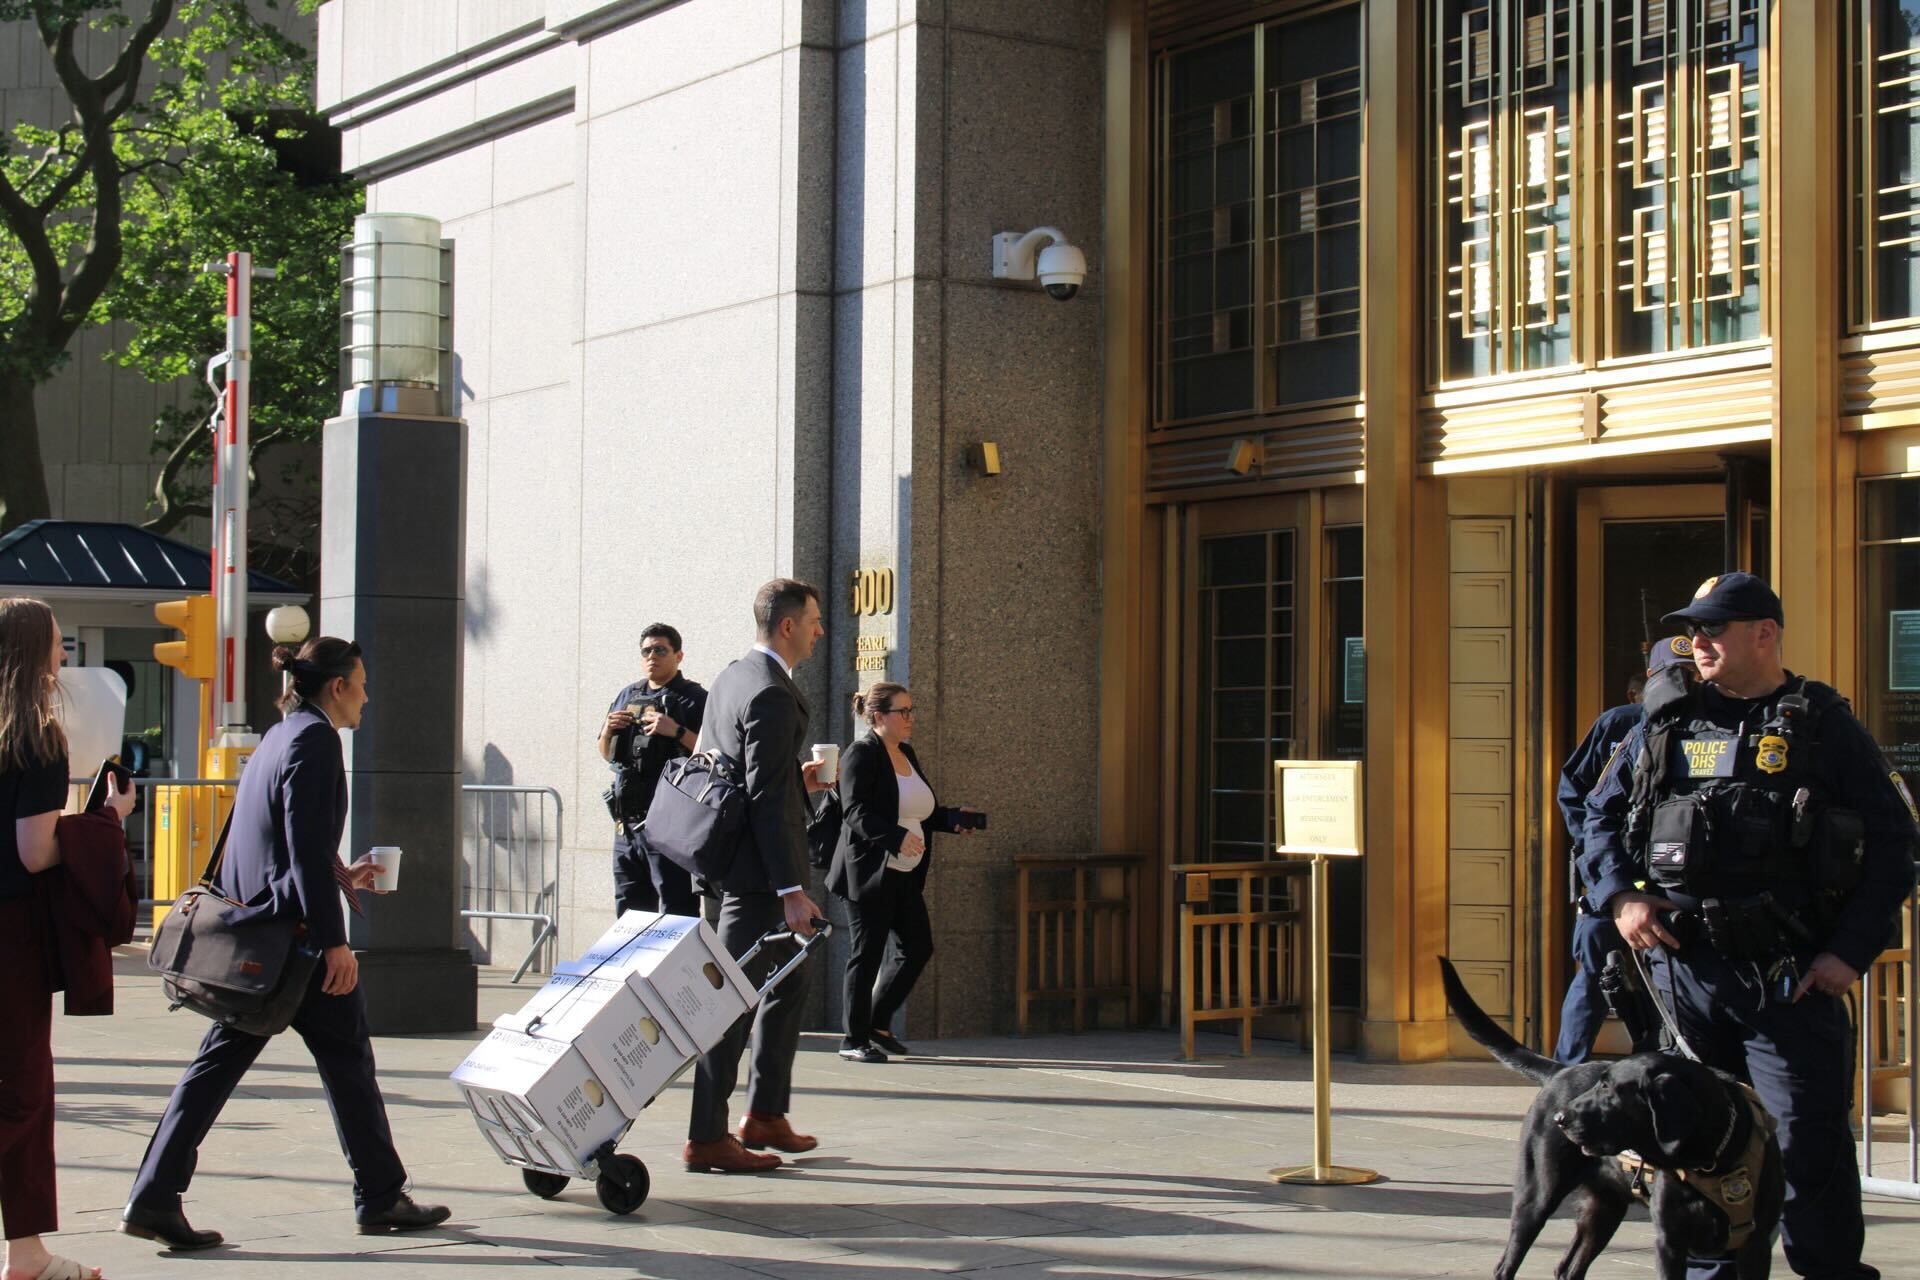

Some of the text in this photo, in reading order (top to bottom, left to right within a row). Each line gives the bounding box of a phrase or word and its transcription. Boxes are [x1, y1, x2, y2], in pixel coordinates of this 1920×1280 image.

[855, 635, 887, 652] EARL
[1684, 741, 1728, 755] POLICE
[1691, 755, 1716, 769] DHS
[625, 926, 665, 939] willams
